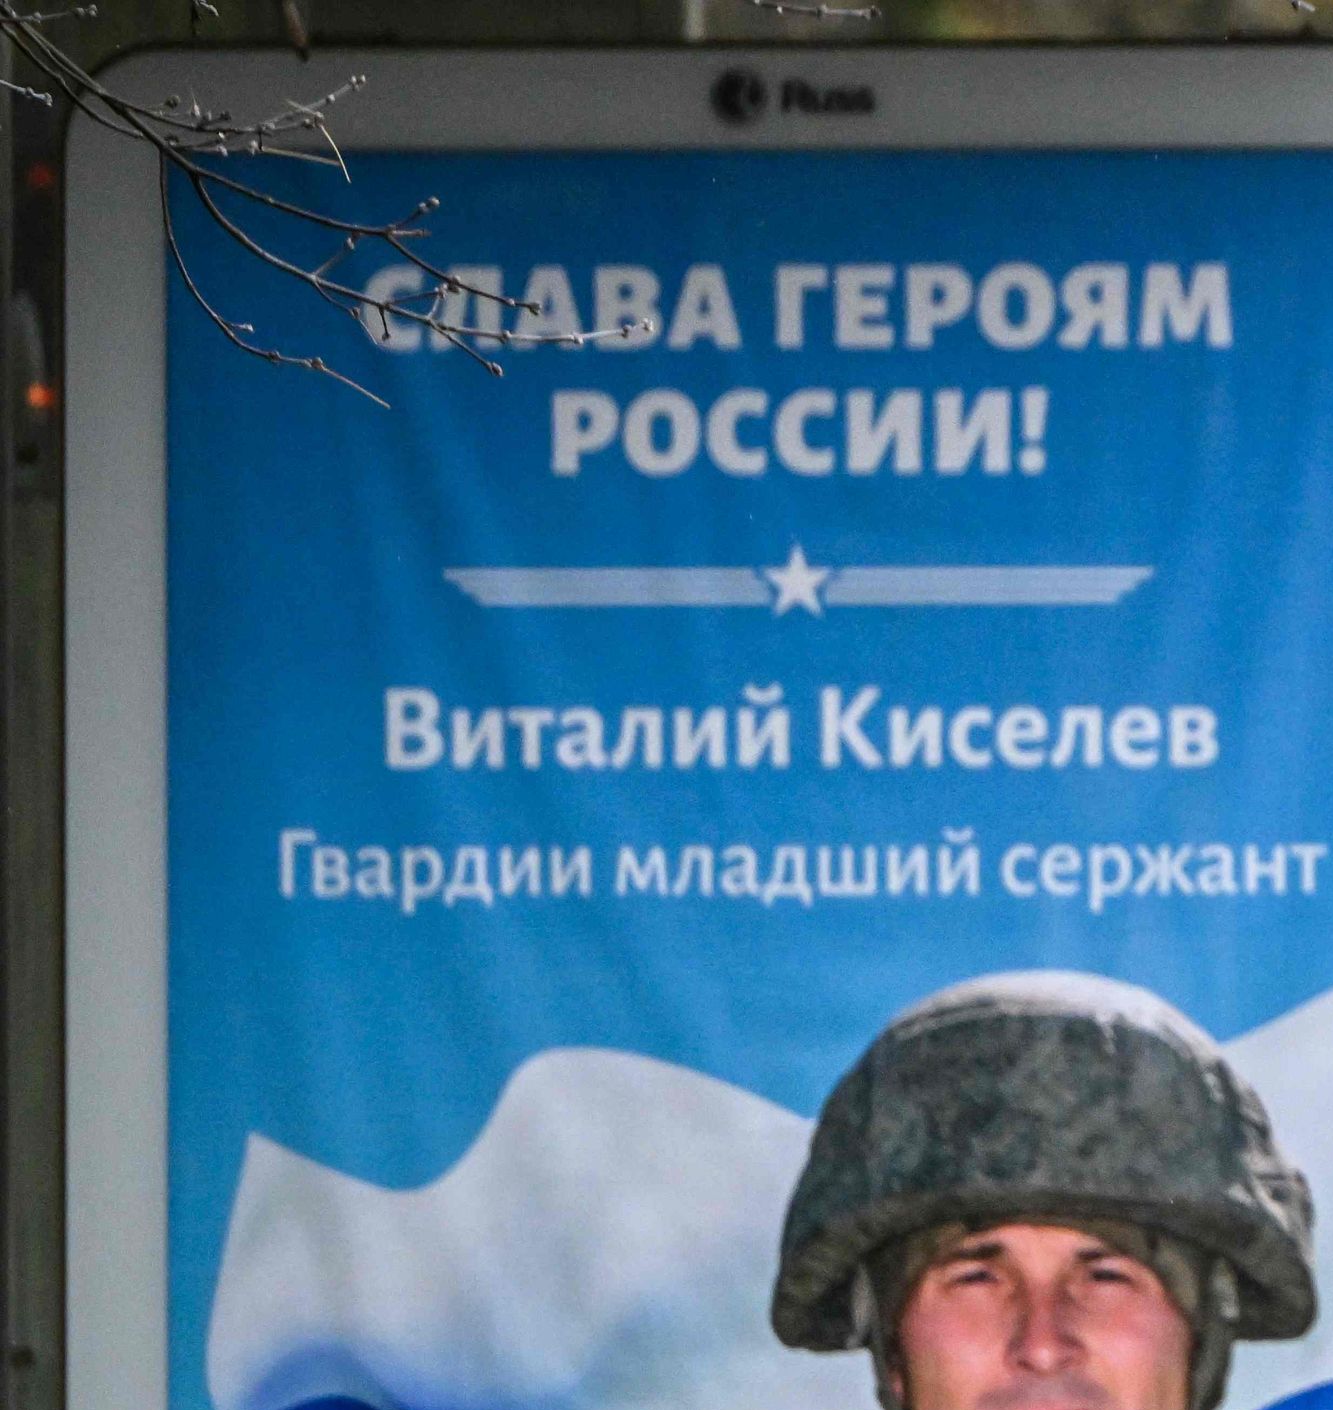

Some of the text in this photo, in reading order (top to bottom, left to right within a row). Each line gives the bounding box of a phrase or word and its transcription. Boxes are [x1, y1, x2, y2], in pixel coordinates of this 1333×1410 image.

[363, 262, 1234, 352] СЛАВА ГЕРОЯМ
[551, 386, 1049, 477] РОССИИ!
[384, 684, 1221, 771] Виталий Киселев
[278, 826, 1328, 915] Гвардии младший сержант
